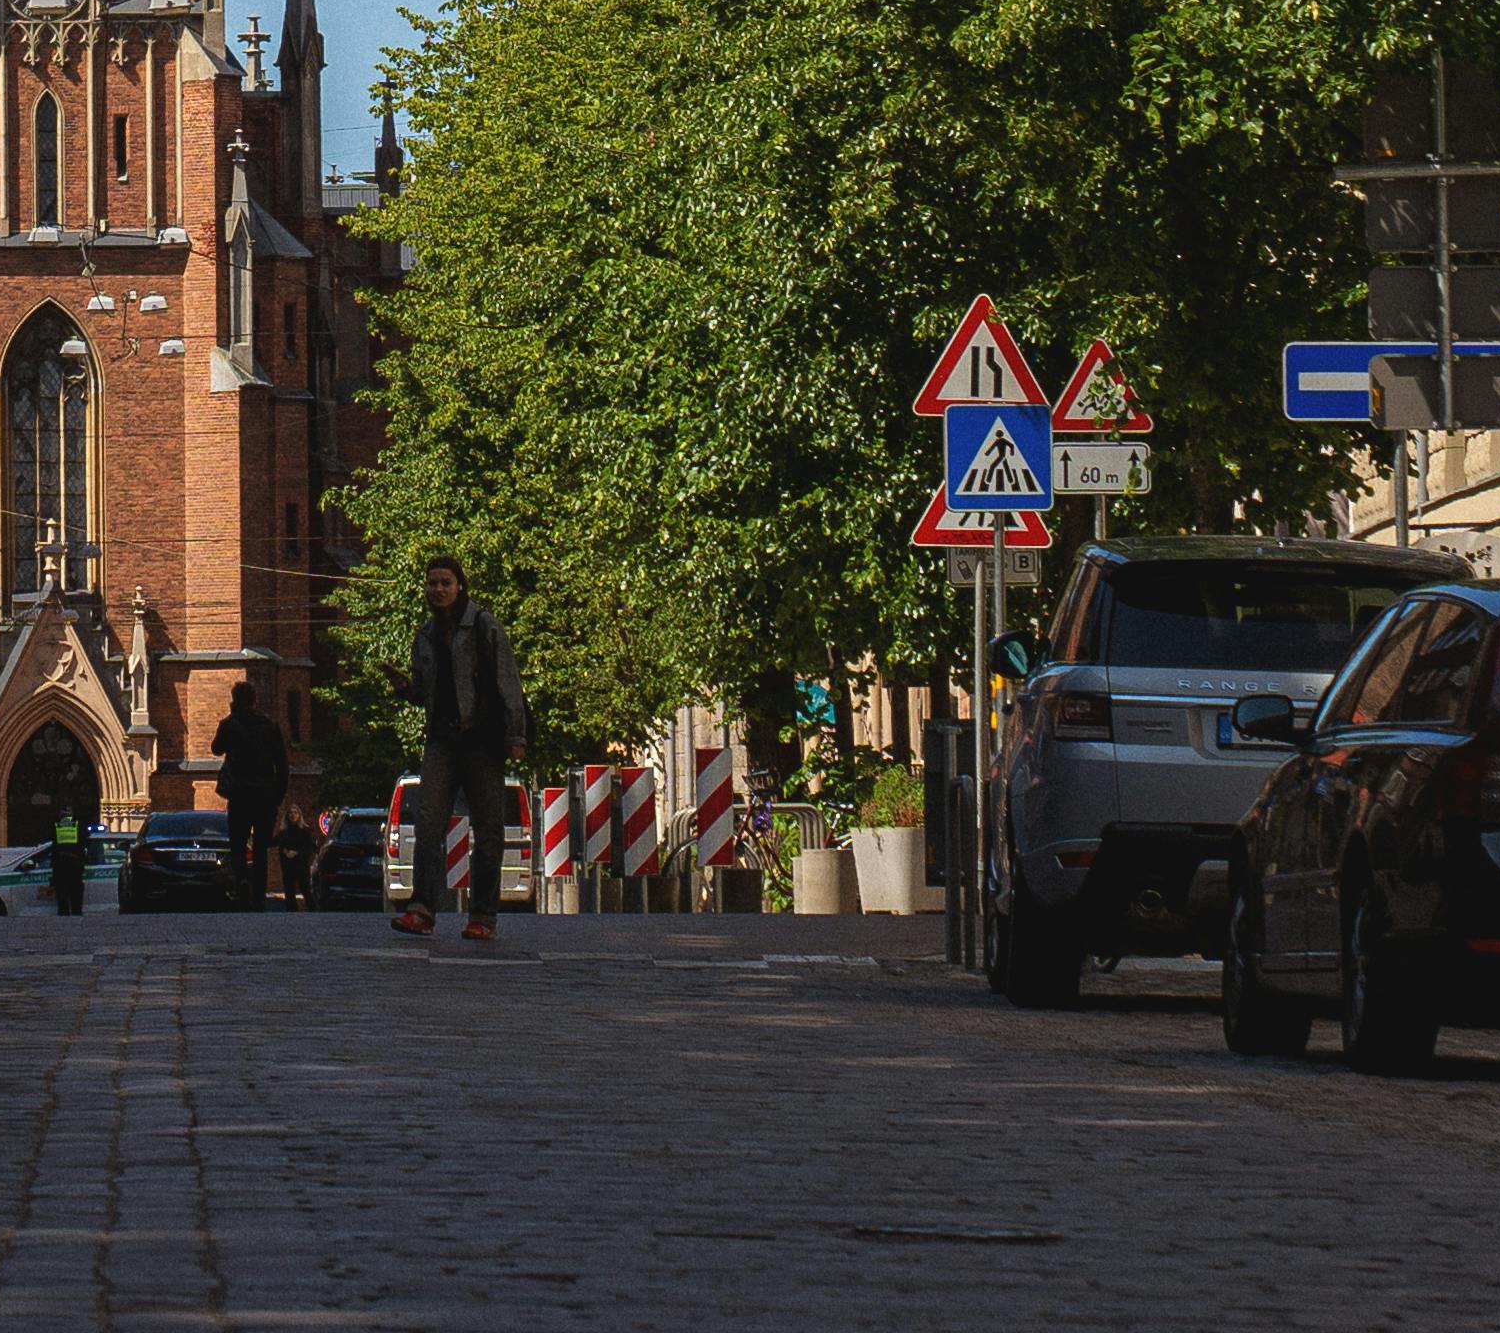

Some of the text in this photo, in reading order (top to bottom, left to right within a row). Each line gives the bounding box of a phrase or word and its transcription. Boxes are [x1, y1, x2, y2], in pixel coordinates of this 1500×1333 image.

[1080, 467, 1119, 484] 60 m
[1019, 555, 1030, 569] B
[1176, 679, 1280, 693] RANGE
